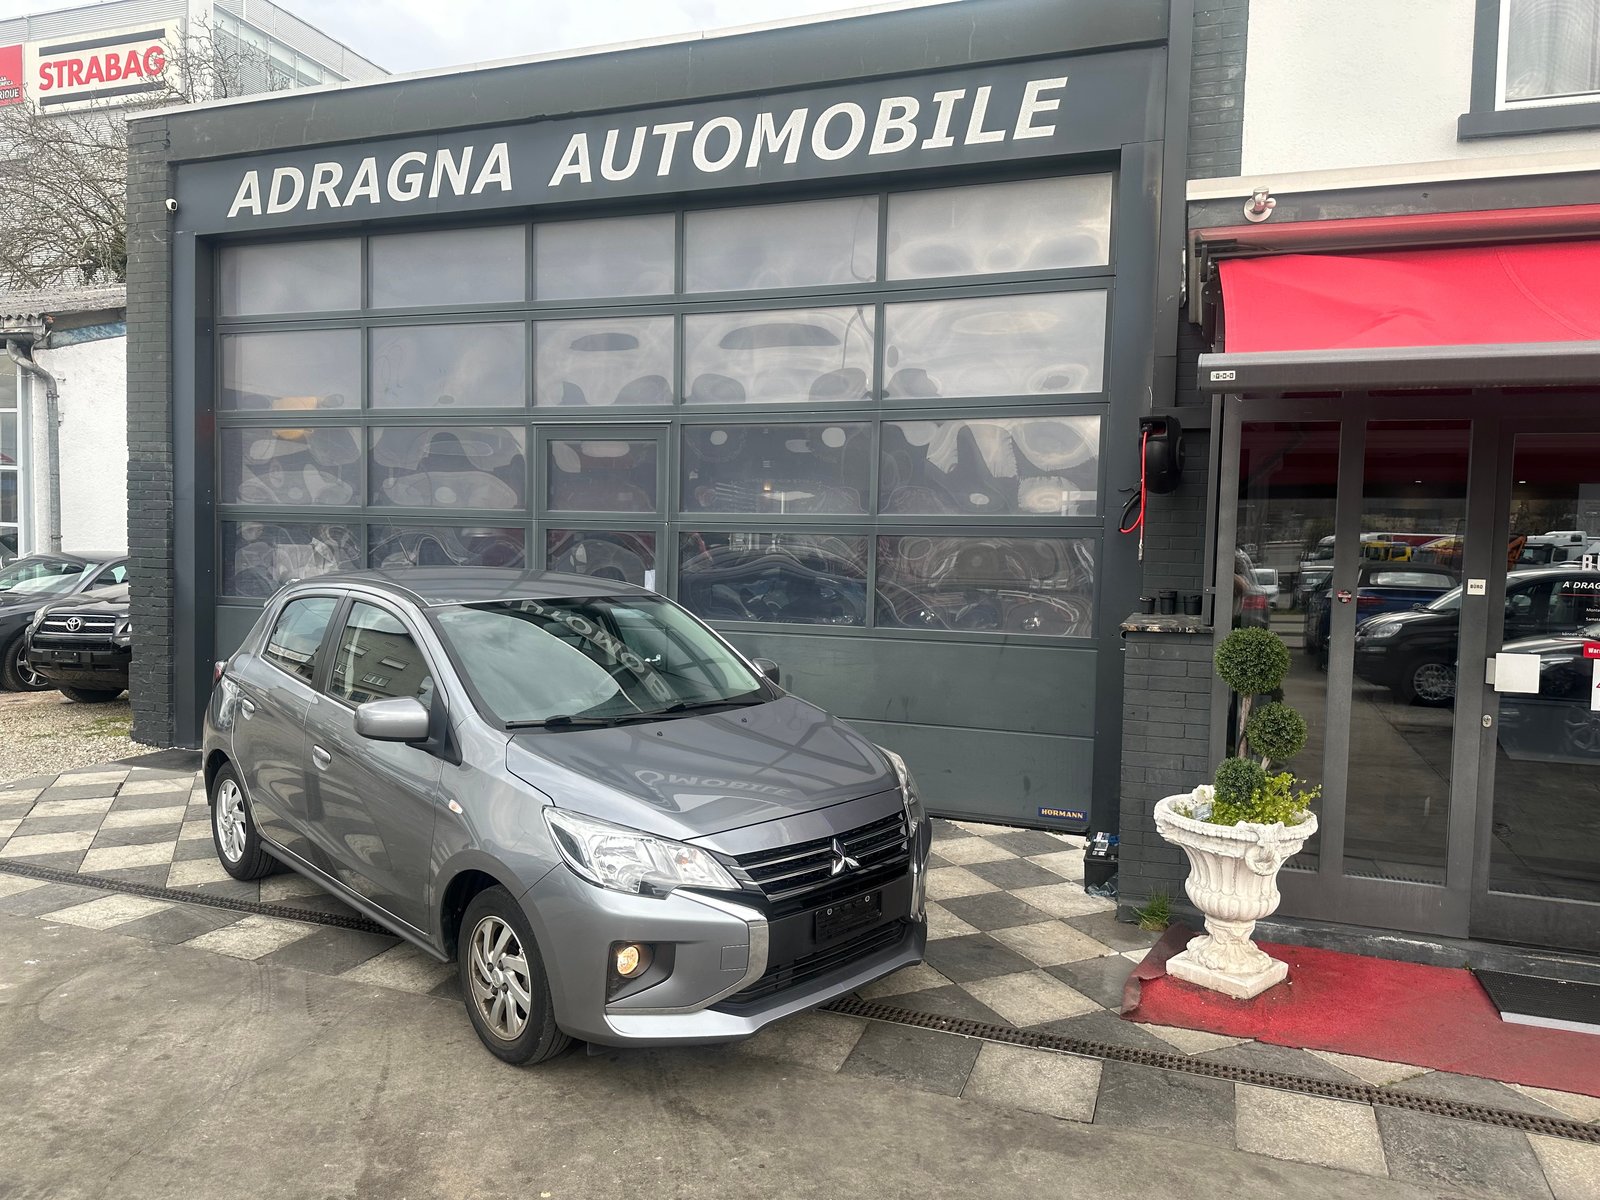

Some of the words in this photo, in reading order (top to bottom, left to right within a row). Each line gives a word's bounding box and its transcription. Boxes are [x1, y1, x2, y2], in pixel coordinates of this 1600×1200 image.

[38, 45, 166, 91] STRABAG
[226, 142, 512, 219] ADRAGNA
[548, 76, 1068, 189] AUTOMOBILE
